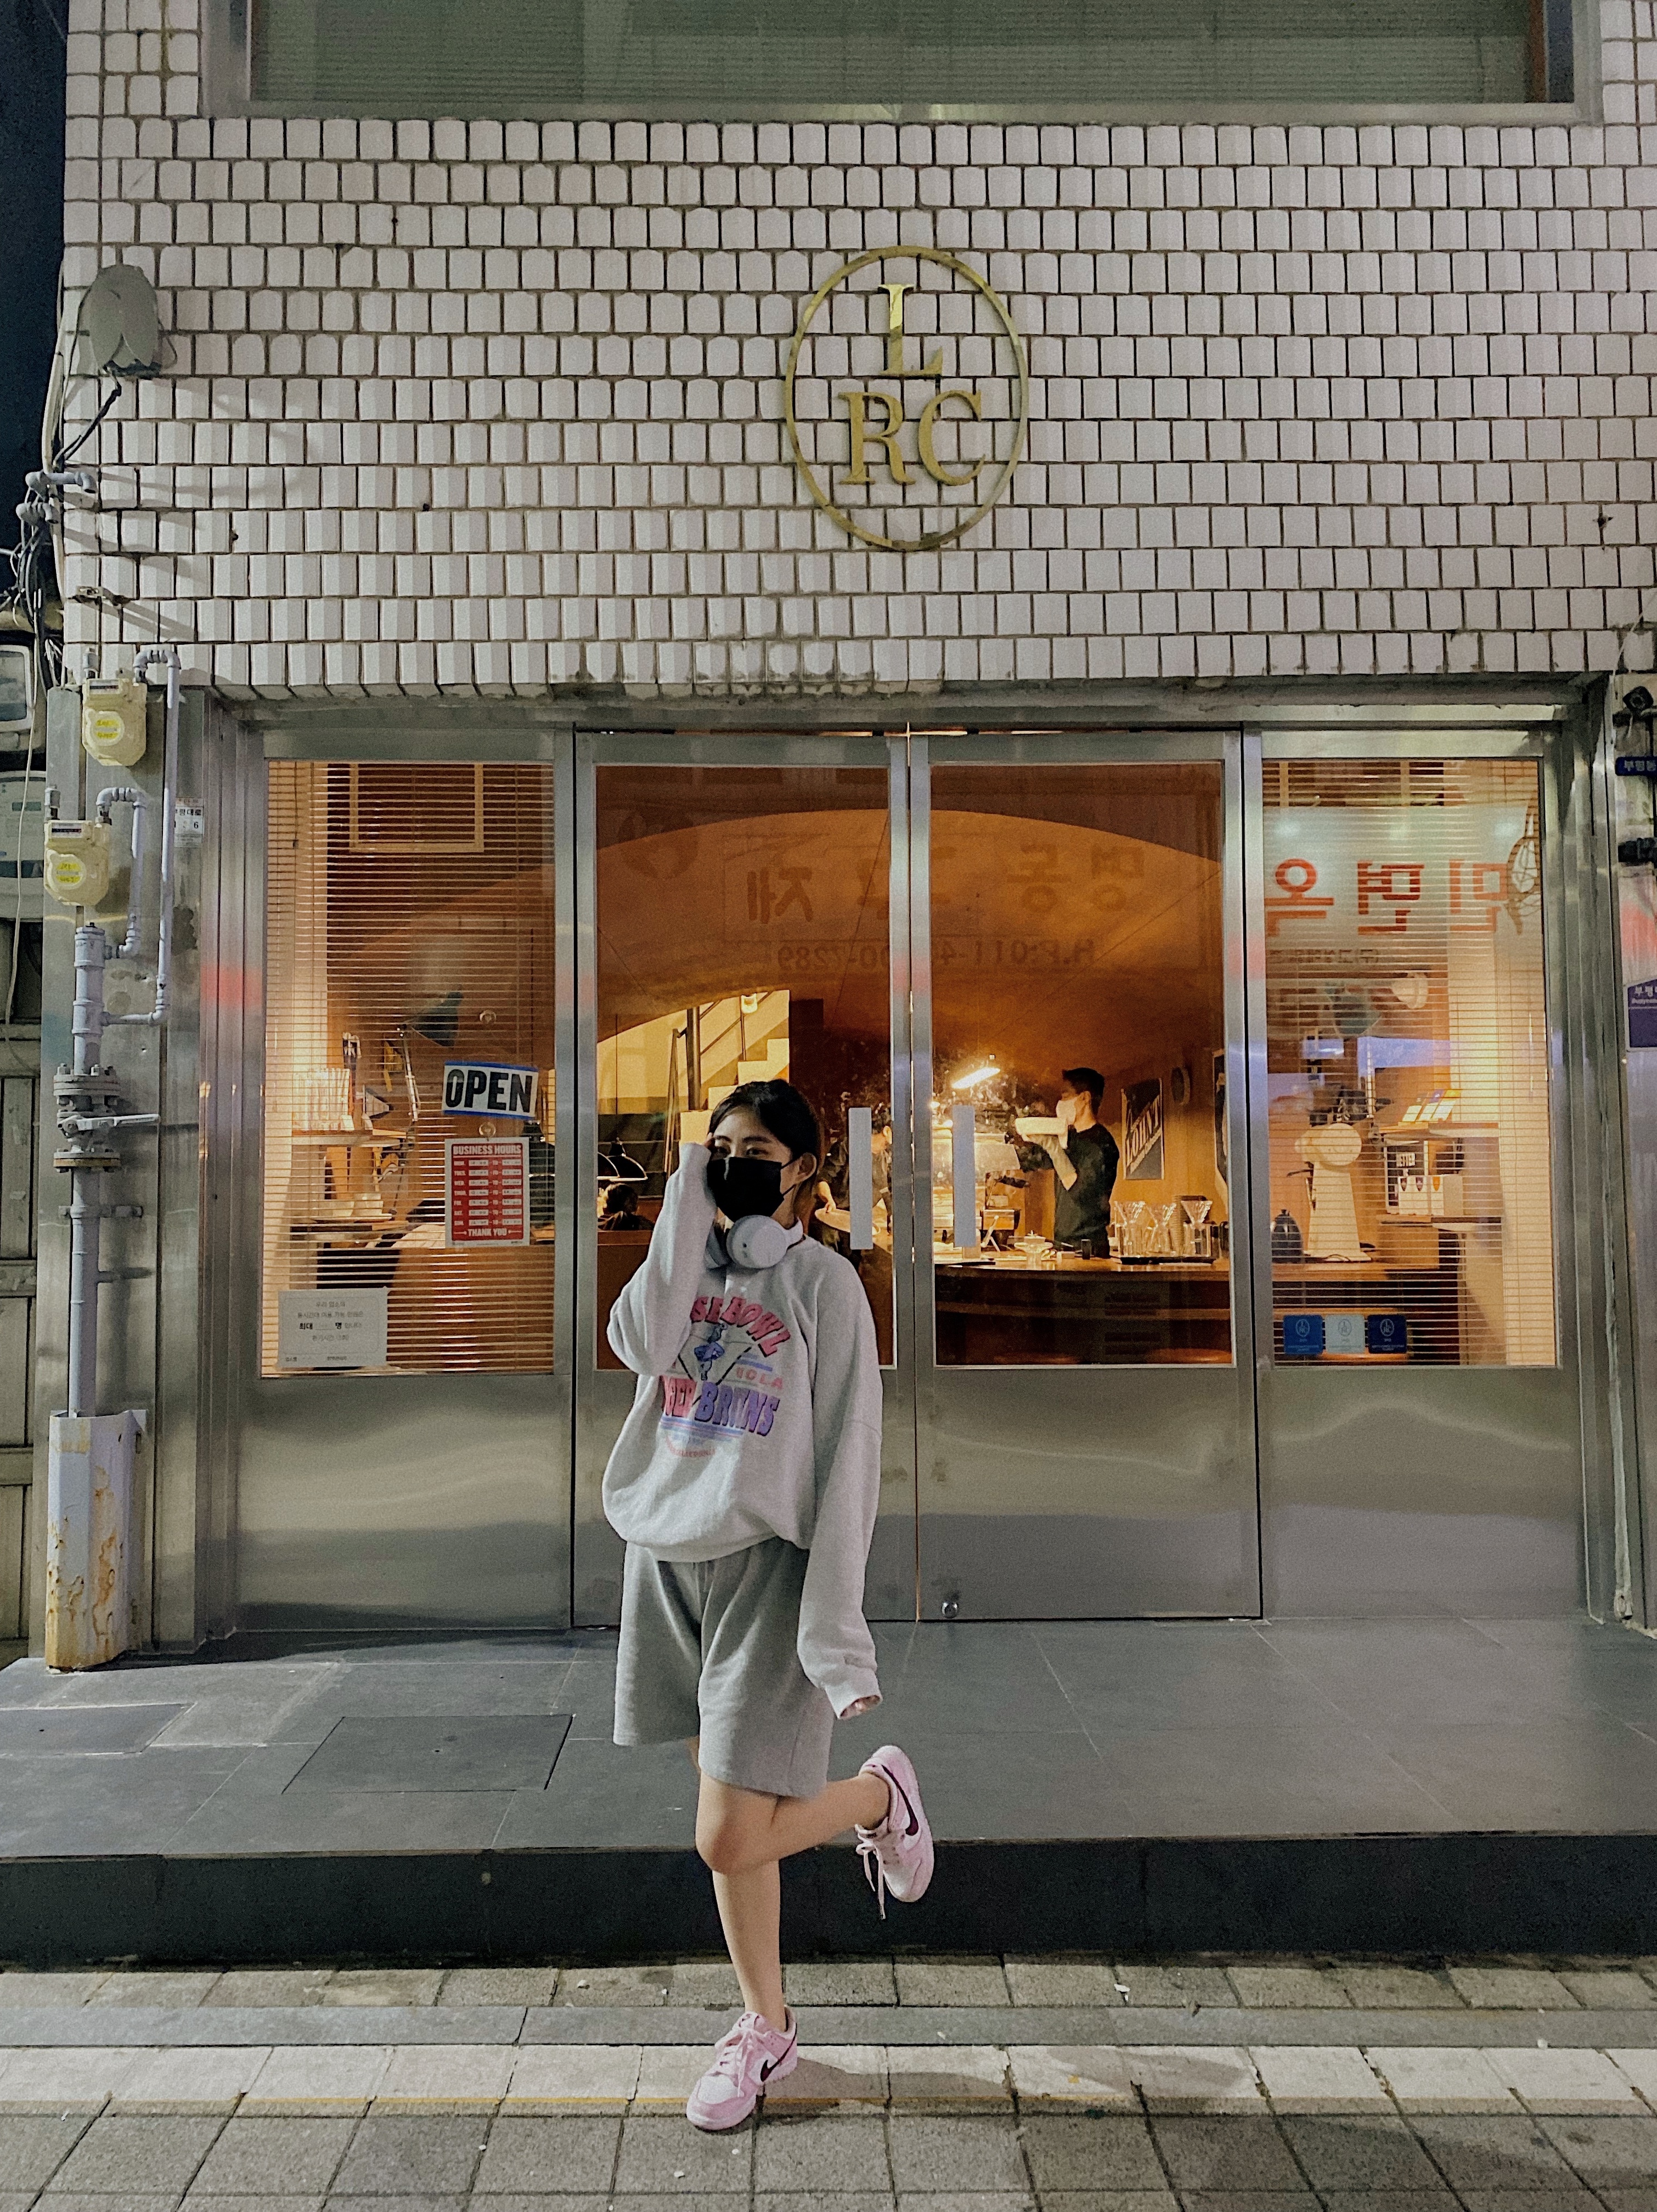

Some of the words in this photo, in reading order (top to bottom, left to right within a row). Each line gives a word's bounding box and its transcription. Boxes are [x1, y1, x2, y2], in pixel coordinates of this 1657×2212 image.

[878, 284, 943, 376] L
[838, 390, 986, 486] RC
[446, 1069, 533, 1113] OPEN
[453, 1146, 493, 1155] BUSINESS
[494, 1144, 521, 1154] HOURS
[467, 1228, 492, 1237] THANK
[493, 1228, 507, 1237] YOU
[690, 1296, 724, 1324] SE
